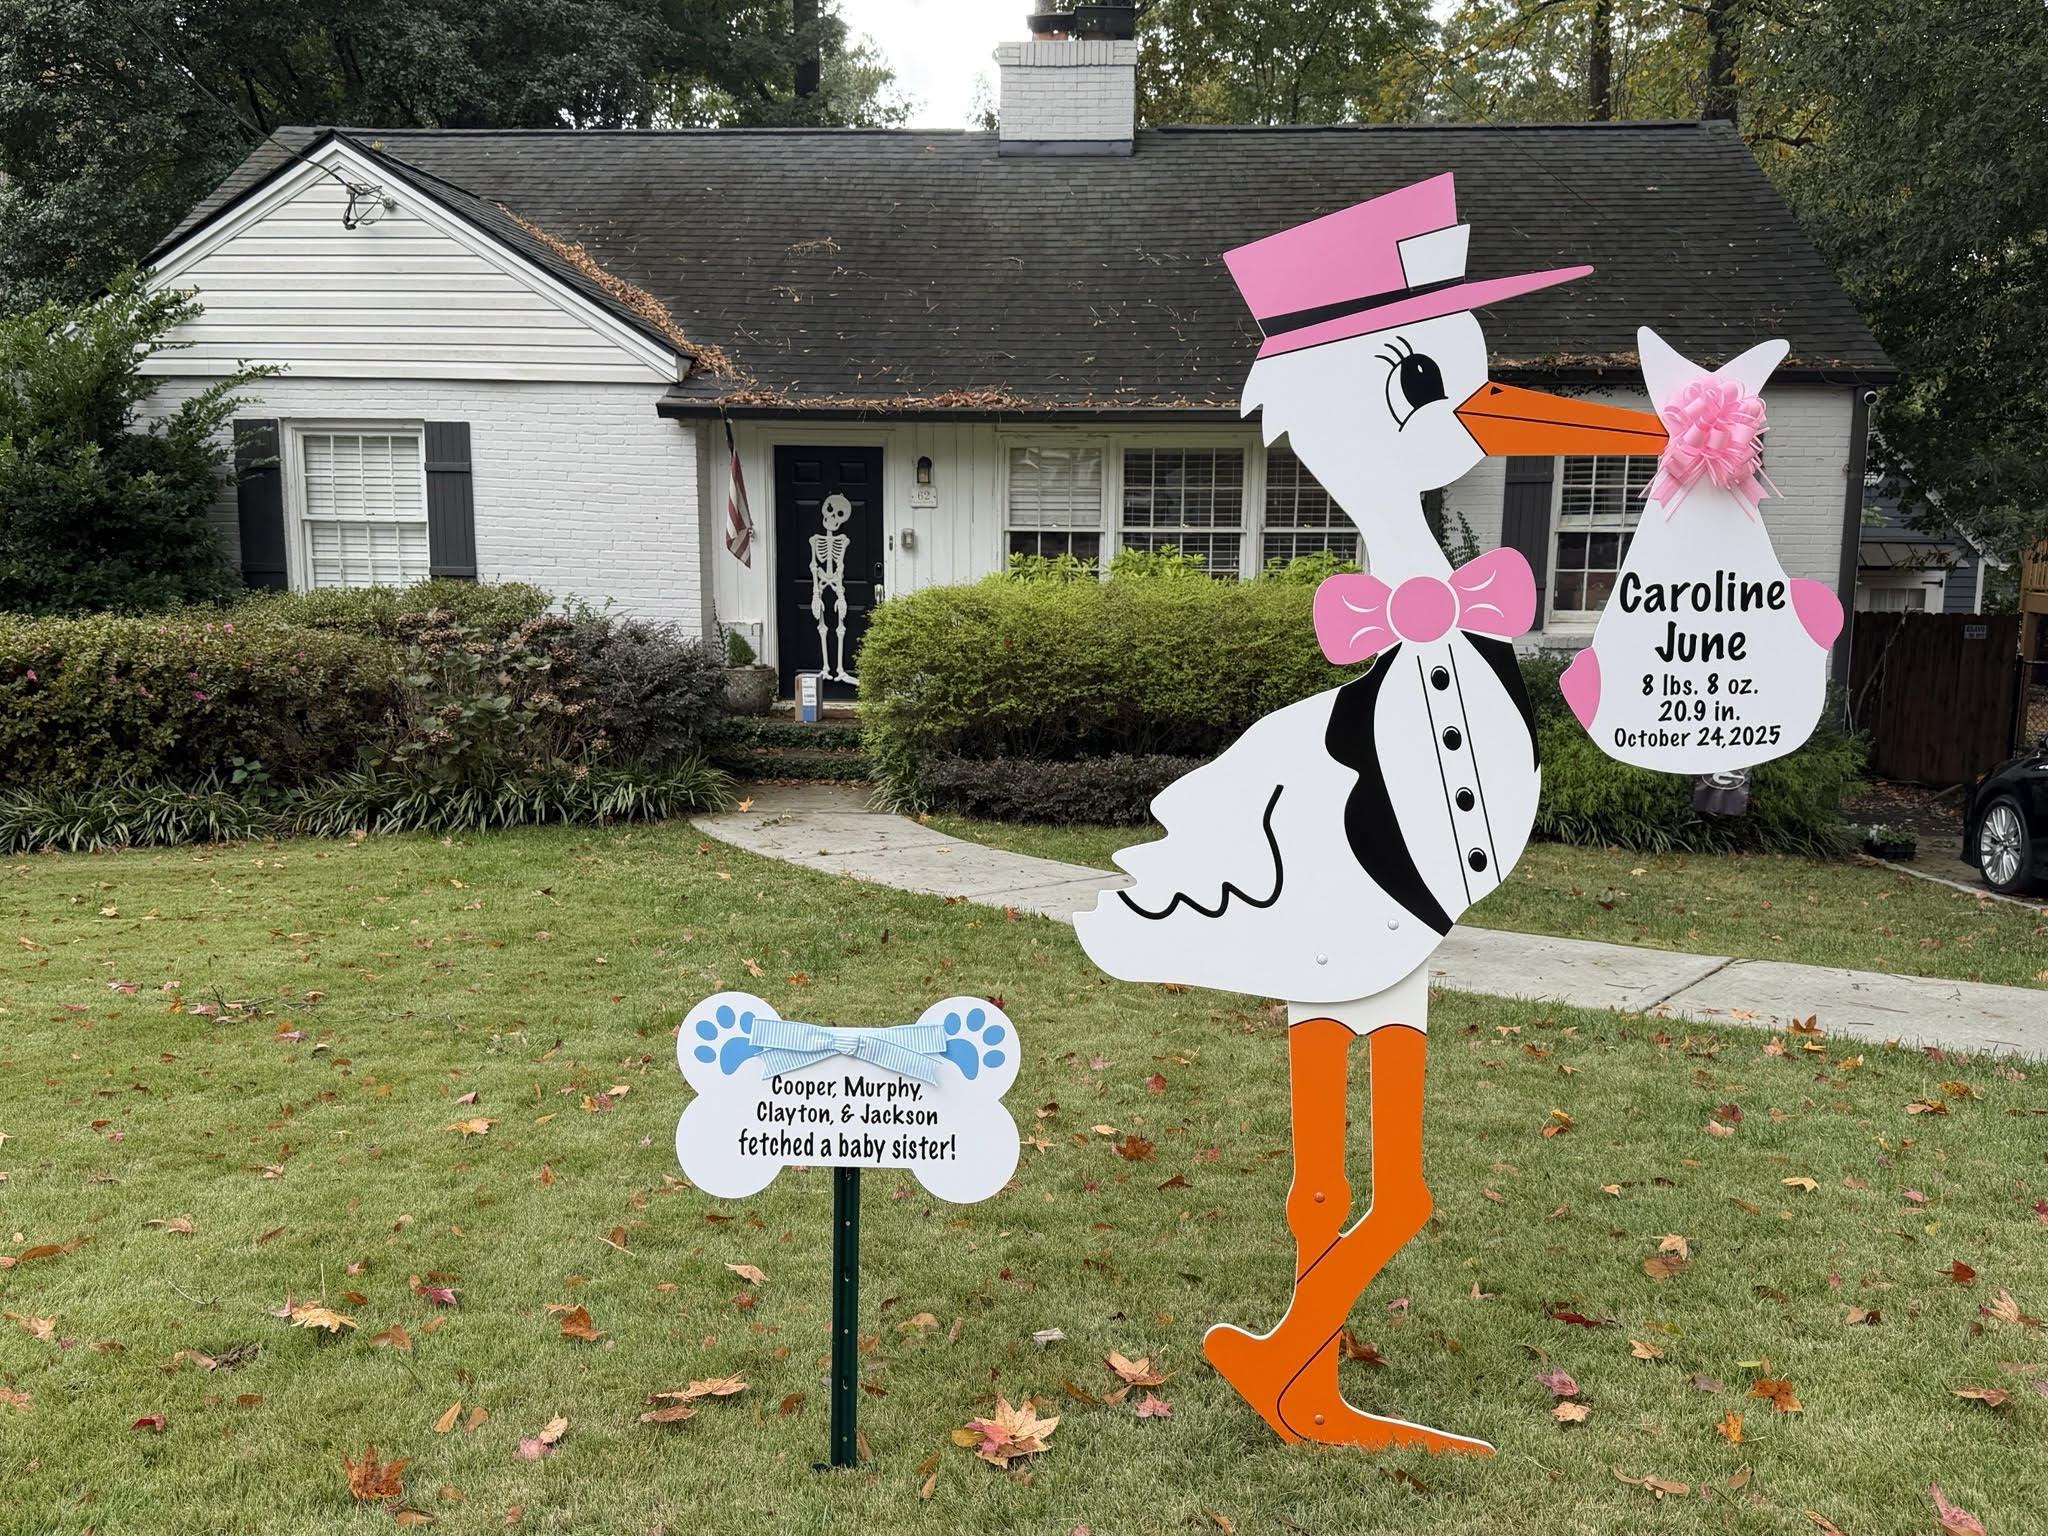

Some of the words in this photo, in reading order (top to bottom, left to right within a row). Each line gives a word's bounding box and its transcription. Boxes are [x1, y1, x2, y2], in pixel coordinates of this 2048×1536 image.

[917, 490, 930, 501] 62
[1619, 570, 1786, 613] Caroline
[1655, 621, 1747, 663] June
[1642, 673, 1654, 696] 8
[1663, 674, 1698, 696] lbs.
[1707, 673, 1719, 695] 8
[1728, 678, 1759, 695] oz.
[1657, 700, 1706, 722] 20.9
[1714, 700, 1740, 722] in.
[1614, 728, 1691, 748] October
[1696, 725, 1782, 749] 24,2025
[771, 1075, 837, 1101] Cooper,
[844, 1076, 923, 1102] Murphy,
[756, 1101, 834, 1126] Clayton,
[840, 1104, 855, 1124] &
[860, 1104, 938, 1126] Jackson
[738, 1128, 814, 1157] fetched
[820, 1138, 832, 1158] a
[838, 1133, 886, 1164] baby
[891, 1133, 956, 1161] sister!
